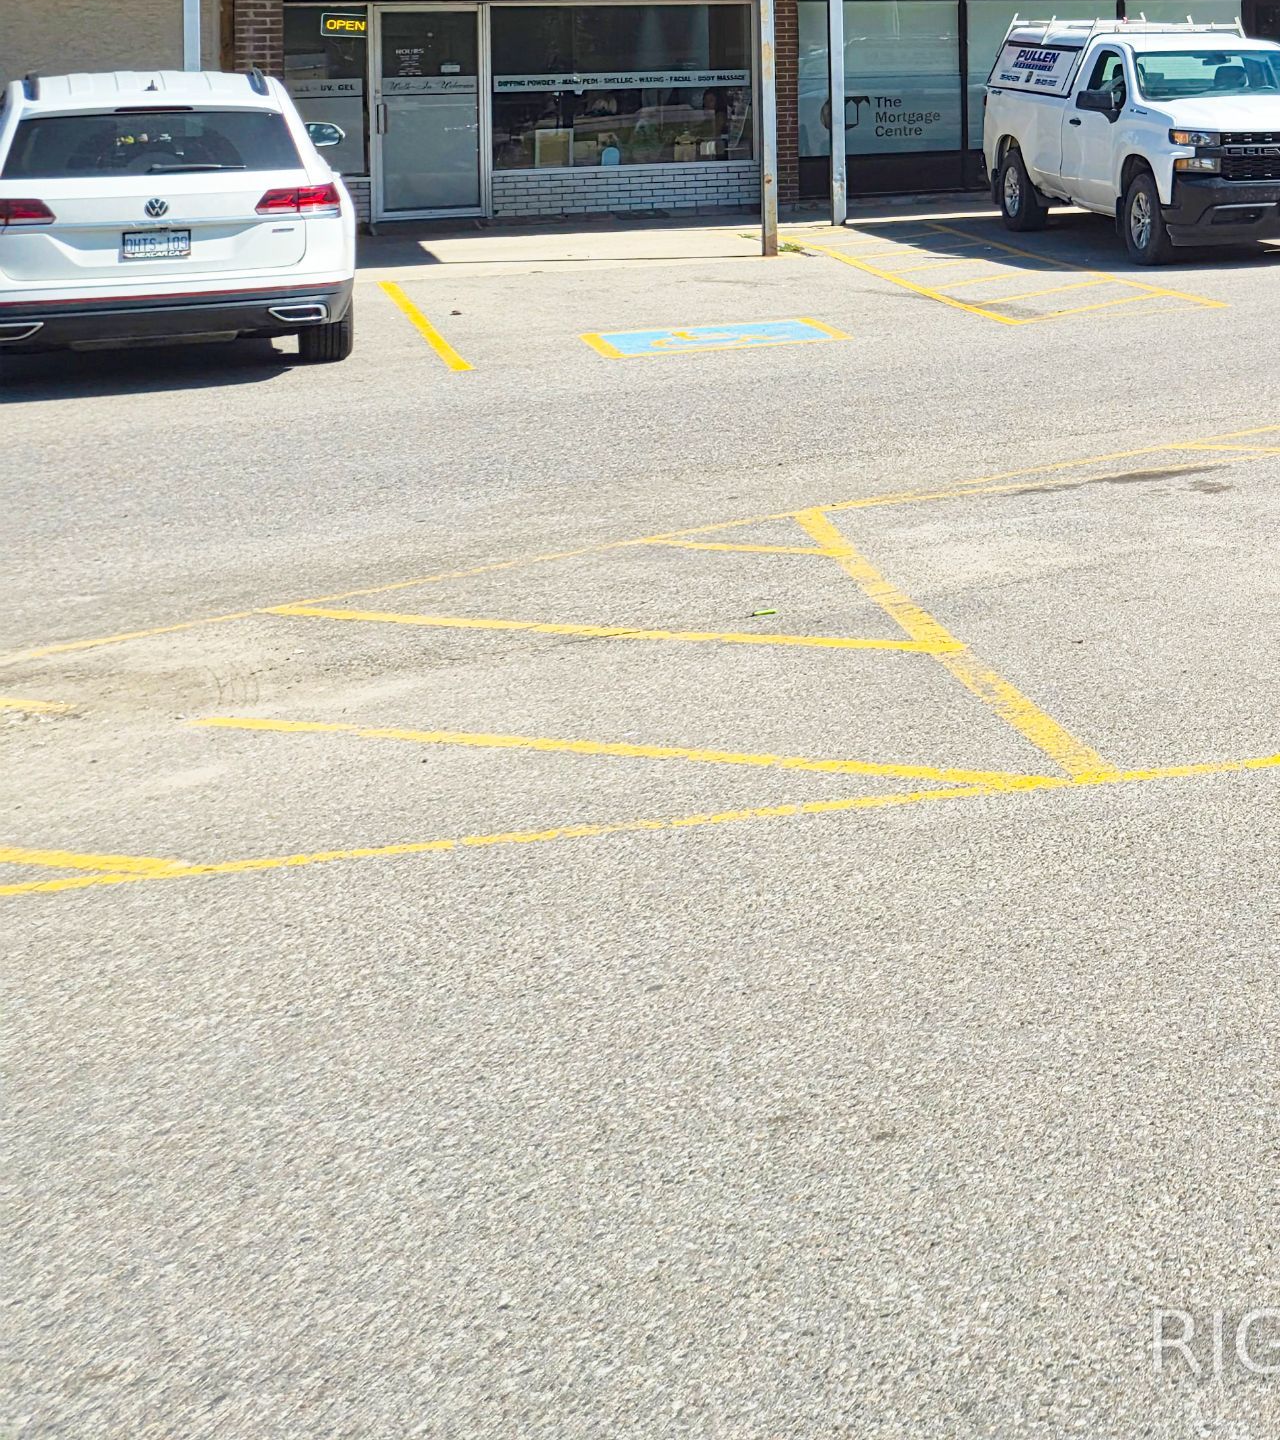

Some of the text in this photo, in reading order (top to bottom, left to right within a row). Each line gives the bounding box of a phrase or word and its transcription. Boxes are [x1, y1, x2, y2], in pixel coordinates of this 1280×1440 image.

[326, 19, 366, 31] OPEN
[1016, 50, 1060, 64] PULLEN
[875, 97, 902, 108] The
[875, 112, 940, 124] Mortgage
[875, 126, 923, 137] Centre
